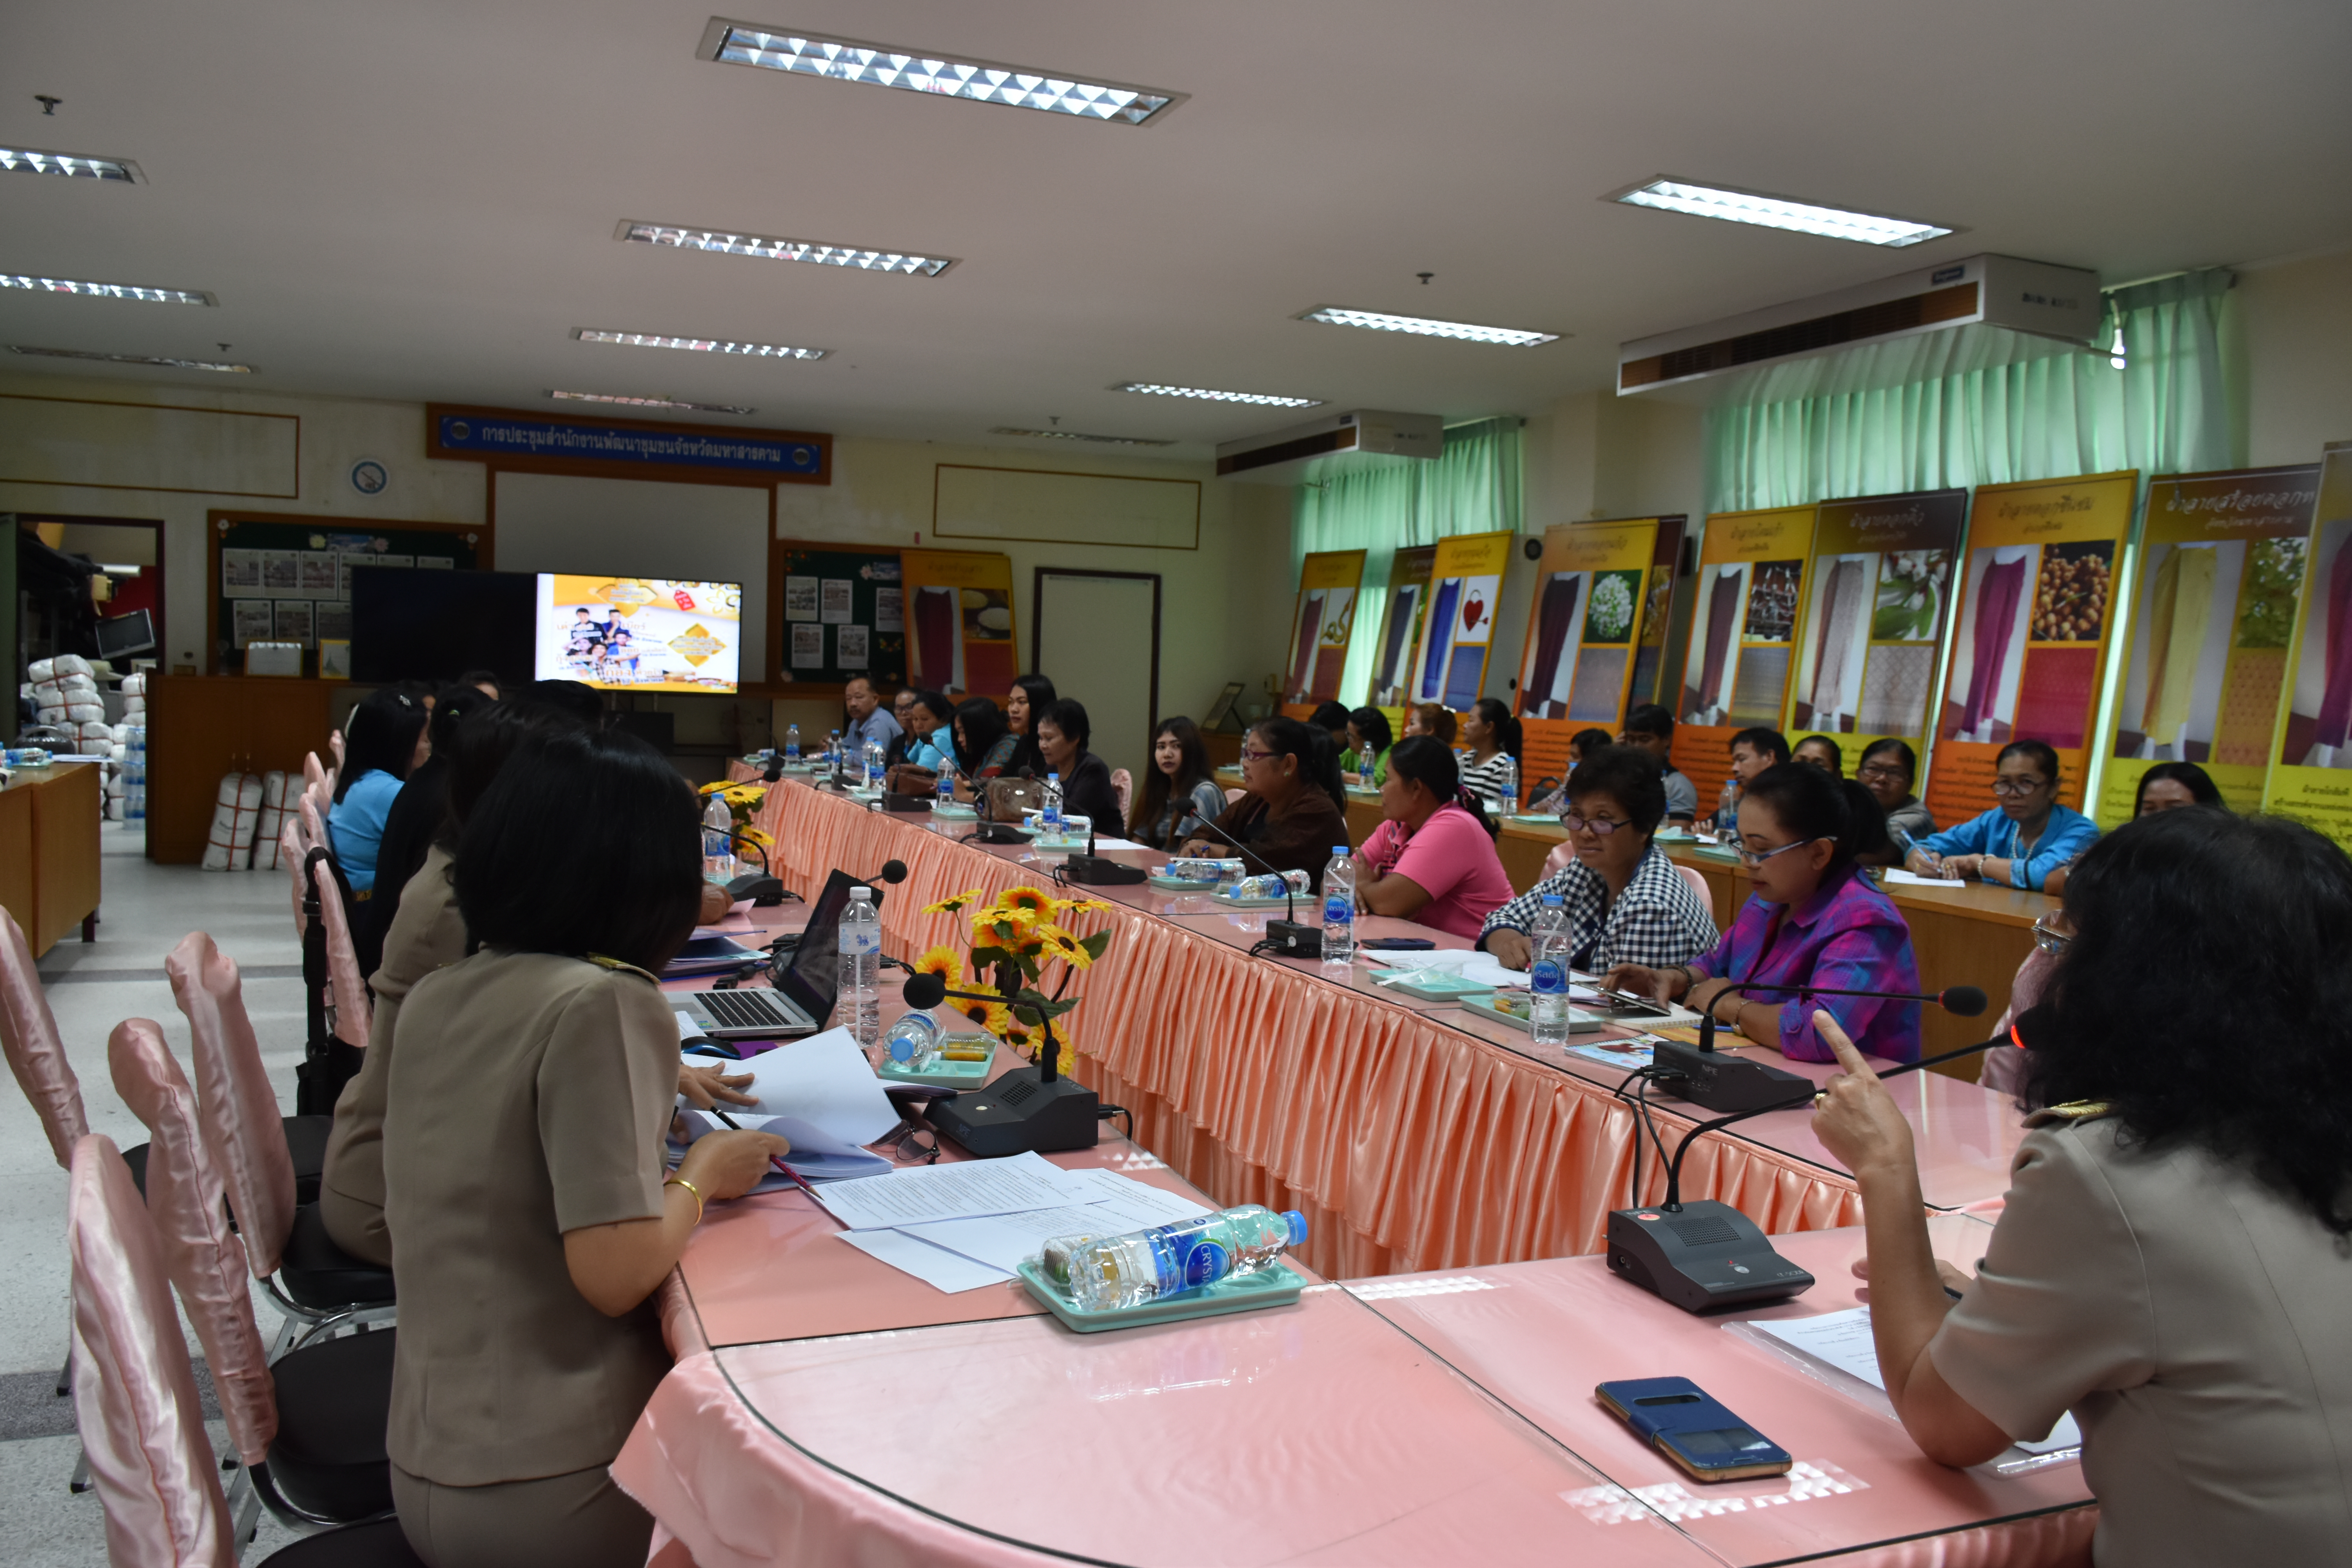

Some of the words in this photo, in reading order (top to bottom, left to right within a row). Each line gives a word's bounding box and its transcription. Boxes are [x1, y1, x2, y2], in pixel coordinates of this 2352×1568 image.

[482, 425, 781, 462] การประชุมสำนักงานพัฒนาชุมชนจังหวัดมหาสารคาม
[1200, 1245, 1213, 1285] CRYSTA
